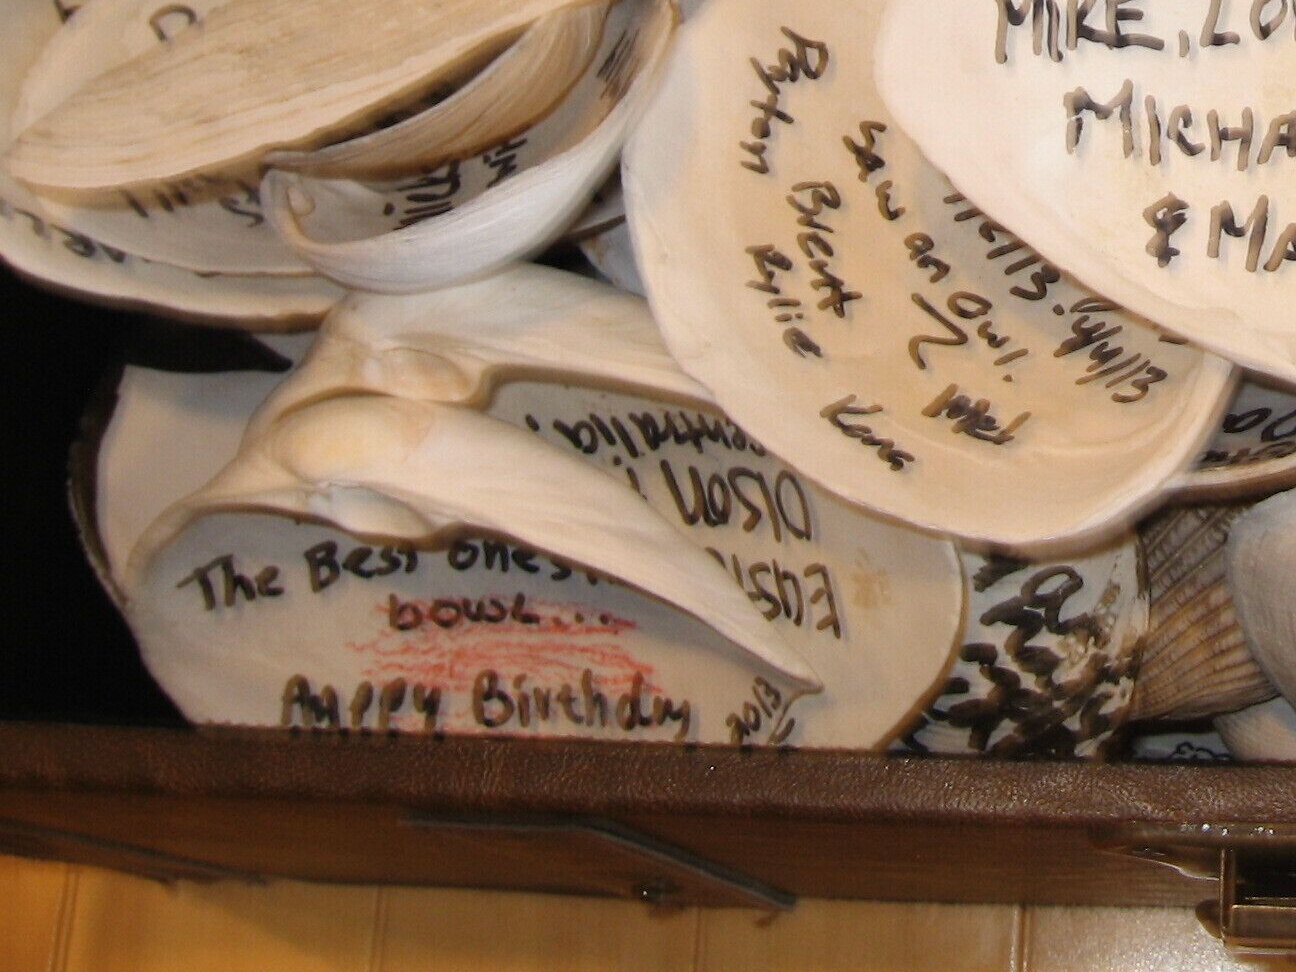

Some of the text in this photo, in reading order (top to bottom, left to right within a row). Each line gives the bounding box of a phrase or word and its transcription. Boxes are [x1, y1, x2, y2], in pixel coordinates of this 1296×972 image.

[787, 181, 863, 319] Brent
[904, 232, 950, 284] an
[659, 459, 812, 543] Olson
[177, 554, 286, 610] The
[303, 540, 418, 592] Best
